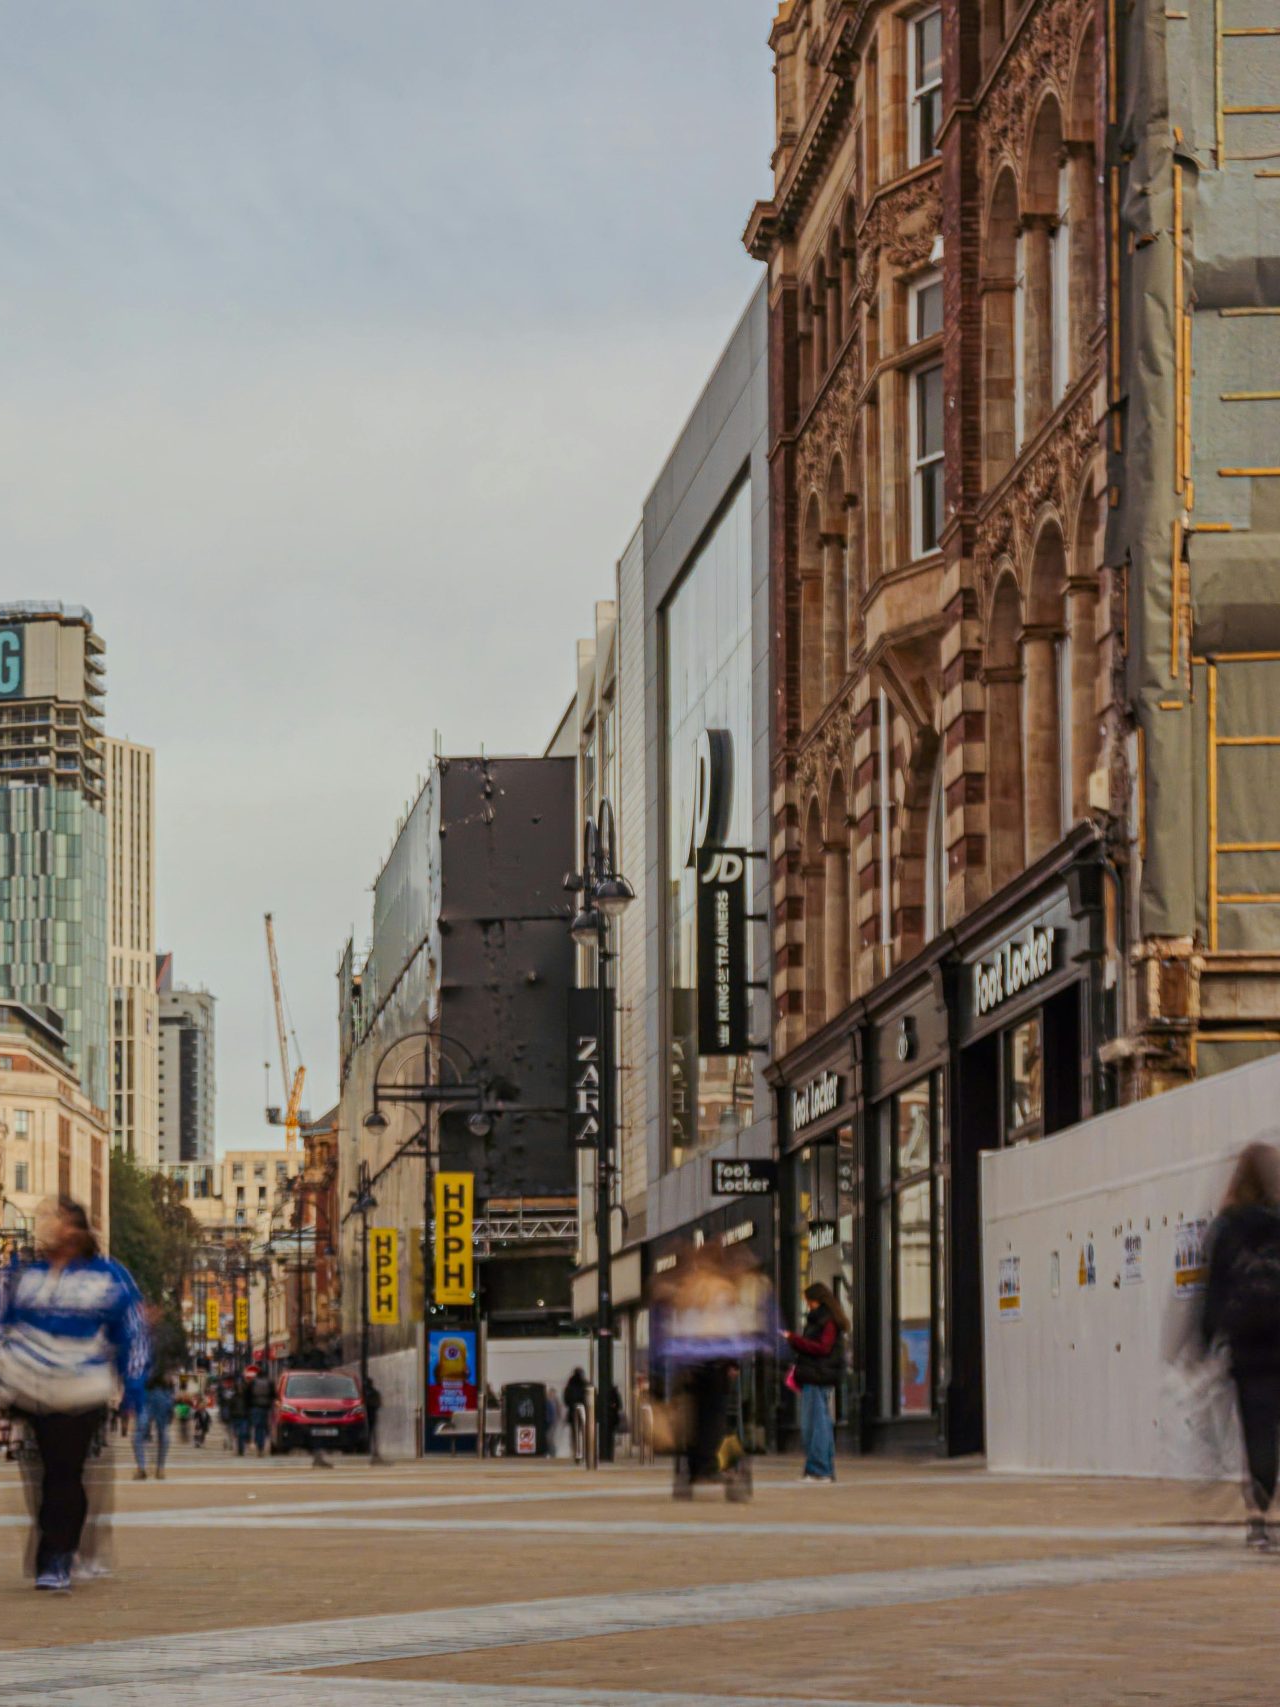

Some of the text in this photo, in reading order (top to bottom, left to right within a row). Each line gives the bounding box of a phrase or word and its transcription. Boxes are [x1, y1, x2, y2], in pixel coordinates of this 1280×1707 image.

[702, 854, 743, 884] JD
[717, 890, 729, 1021] KING OF TRAINERS
[975, 926, 1054, 1017] Foot Locker
[576, 1036, 600, 1140] ZARA
[793, 1071, 838, 1131] Foot Locker
[717, 1162, 751, 1177] Foot
[717, 1177, 770, 1192] Locker
[376, 1235, 393, 1312] HPPH
[443, 1184, 465, 1288] HPPH
